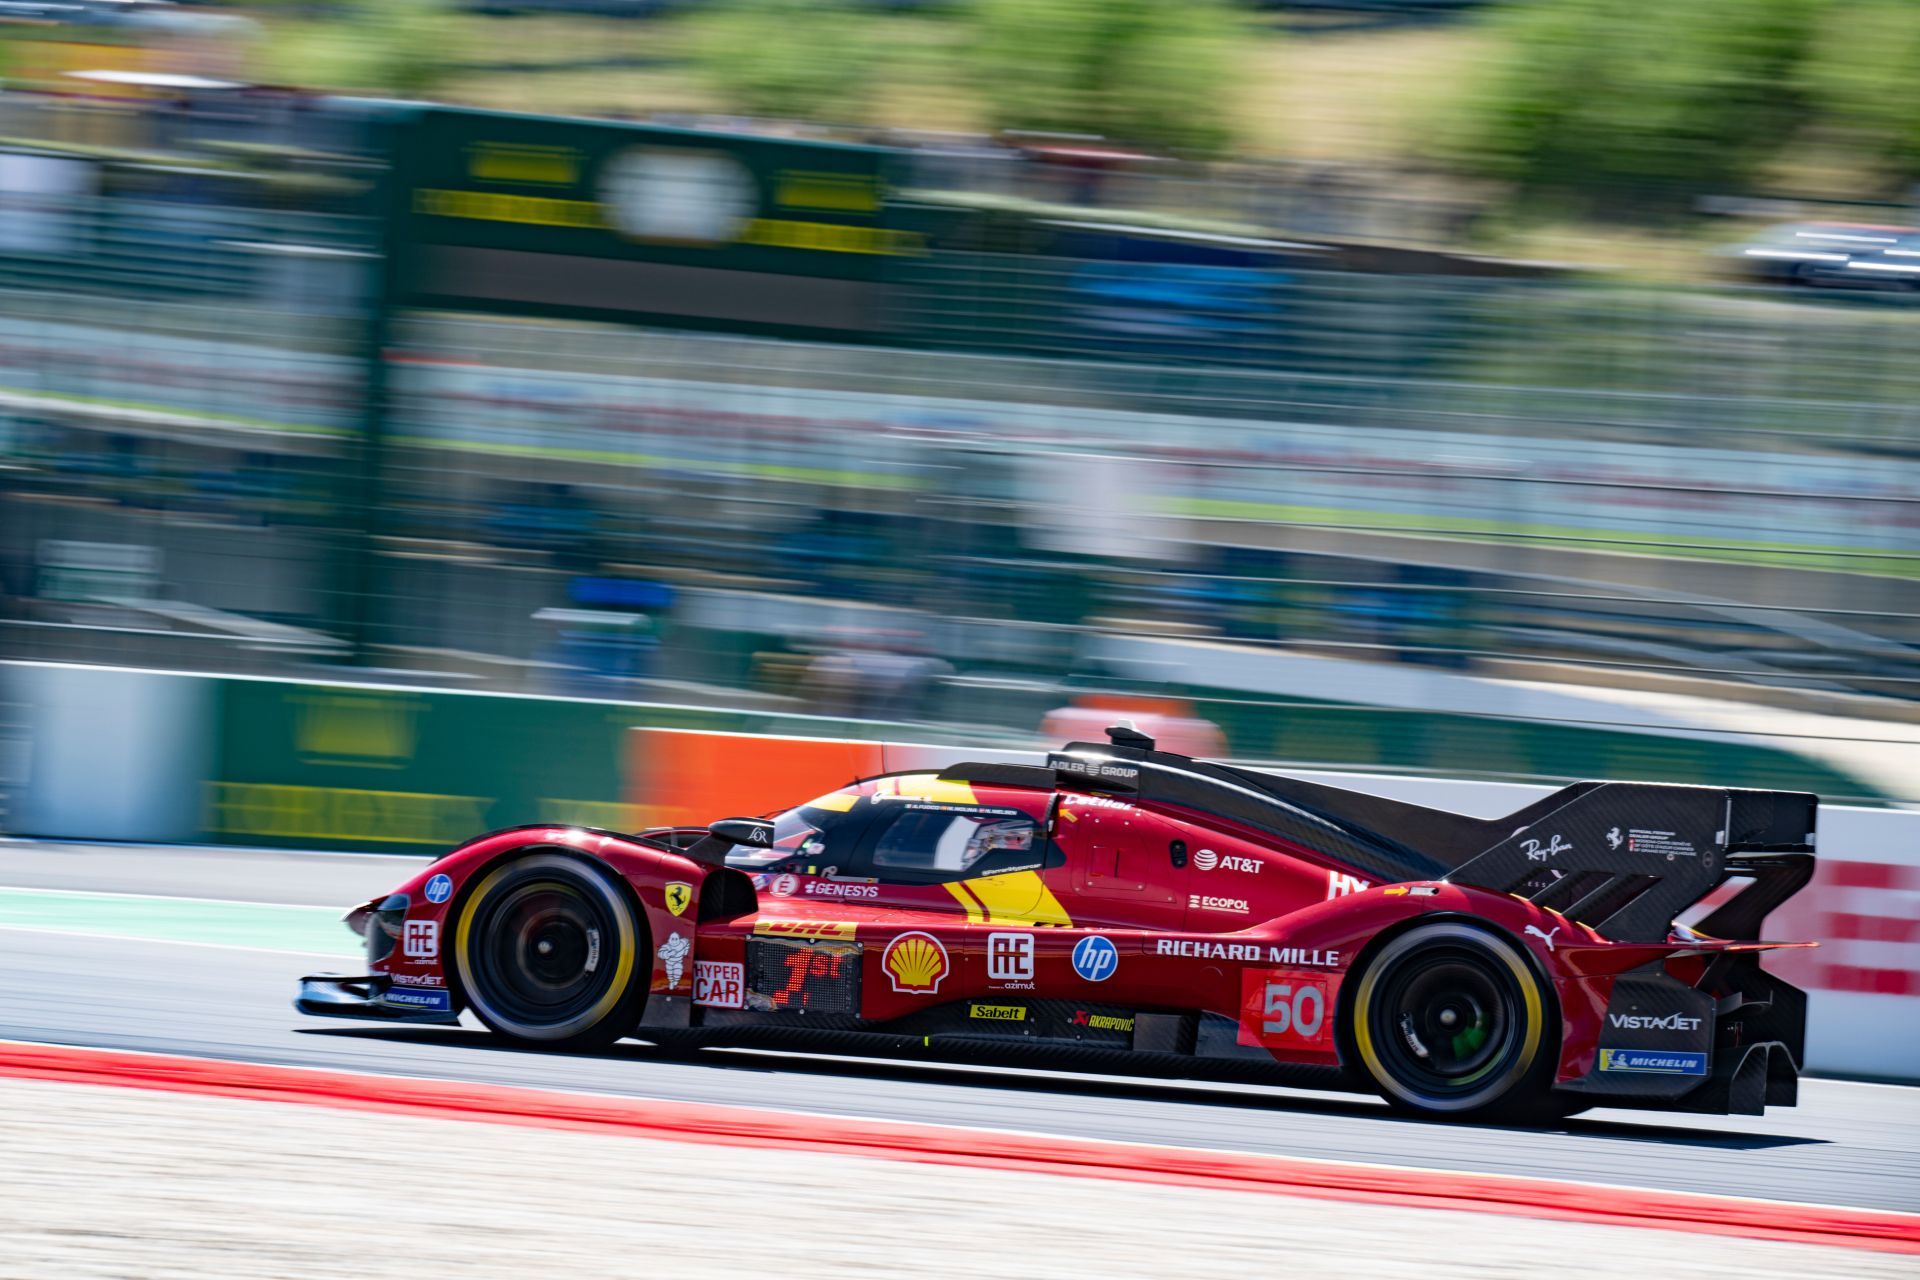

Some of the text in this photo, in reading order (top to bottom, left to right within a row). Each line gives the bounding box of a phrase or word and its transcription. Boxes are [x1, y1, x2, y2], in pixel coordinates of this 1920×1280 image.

[1048, 760, 1138, 778] ADLER GROUP
[1520, 834, 1573, 862] Ray-Ban
[1219, 855, 1265, 874] AT&T
[428, 875, 448, 903] hp
[815, 882, 879, 898] GENESYS
[1202, 896, 1250, 911] ECOPOL
[768, 923, 843, 936] DHL
[1078, 936, 1112, 981] hp
[1157, 939, 1340, 967] RICHARD MILLE
[694, 964, 740, 981] HYPER
[695, 978, 740, 1004] CAR
[1004, 979, 1035, 990] azimut
[385, 993, 441, 1005] MICHELIN
[976, 1006, 1020, 1019] Sabelt
[1263, 983, 1325, 1037] 50
[1630, 1057, 1698, 1068] MICHELIN
